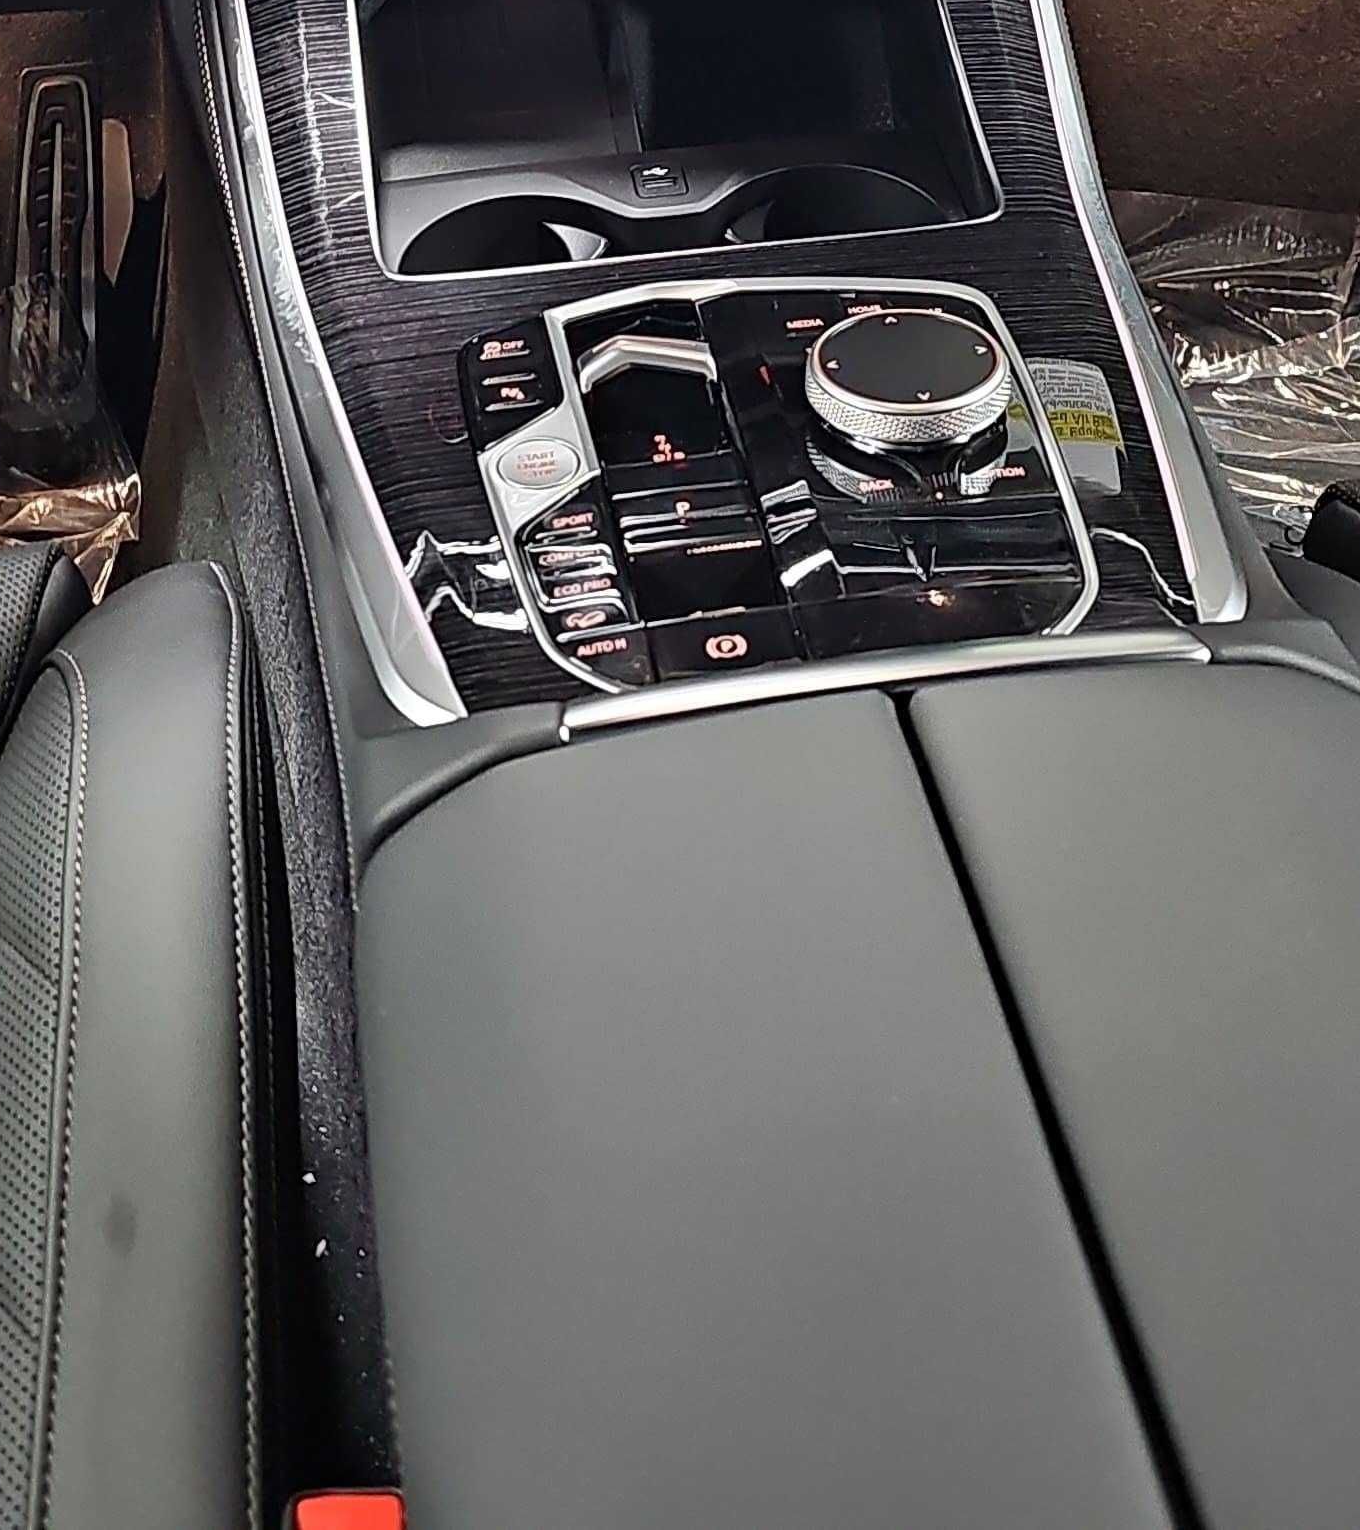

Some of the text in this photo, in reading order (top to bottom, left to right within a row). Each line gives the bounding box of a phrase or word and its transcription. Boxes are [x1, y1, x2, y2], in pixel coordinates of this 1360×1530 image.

[786, 318, 824, 329] MEDIA
[502, 340, 525, 350] OFF
[517, 450, 555, 462] START
[858, 479, 895, 492] BACK
[551, 512, 594, 529] SPORT
[553, 578, 612, 598] ECO PRO
[577, 638, 627, 657] AUTO H
